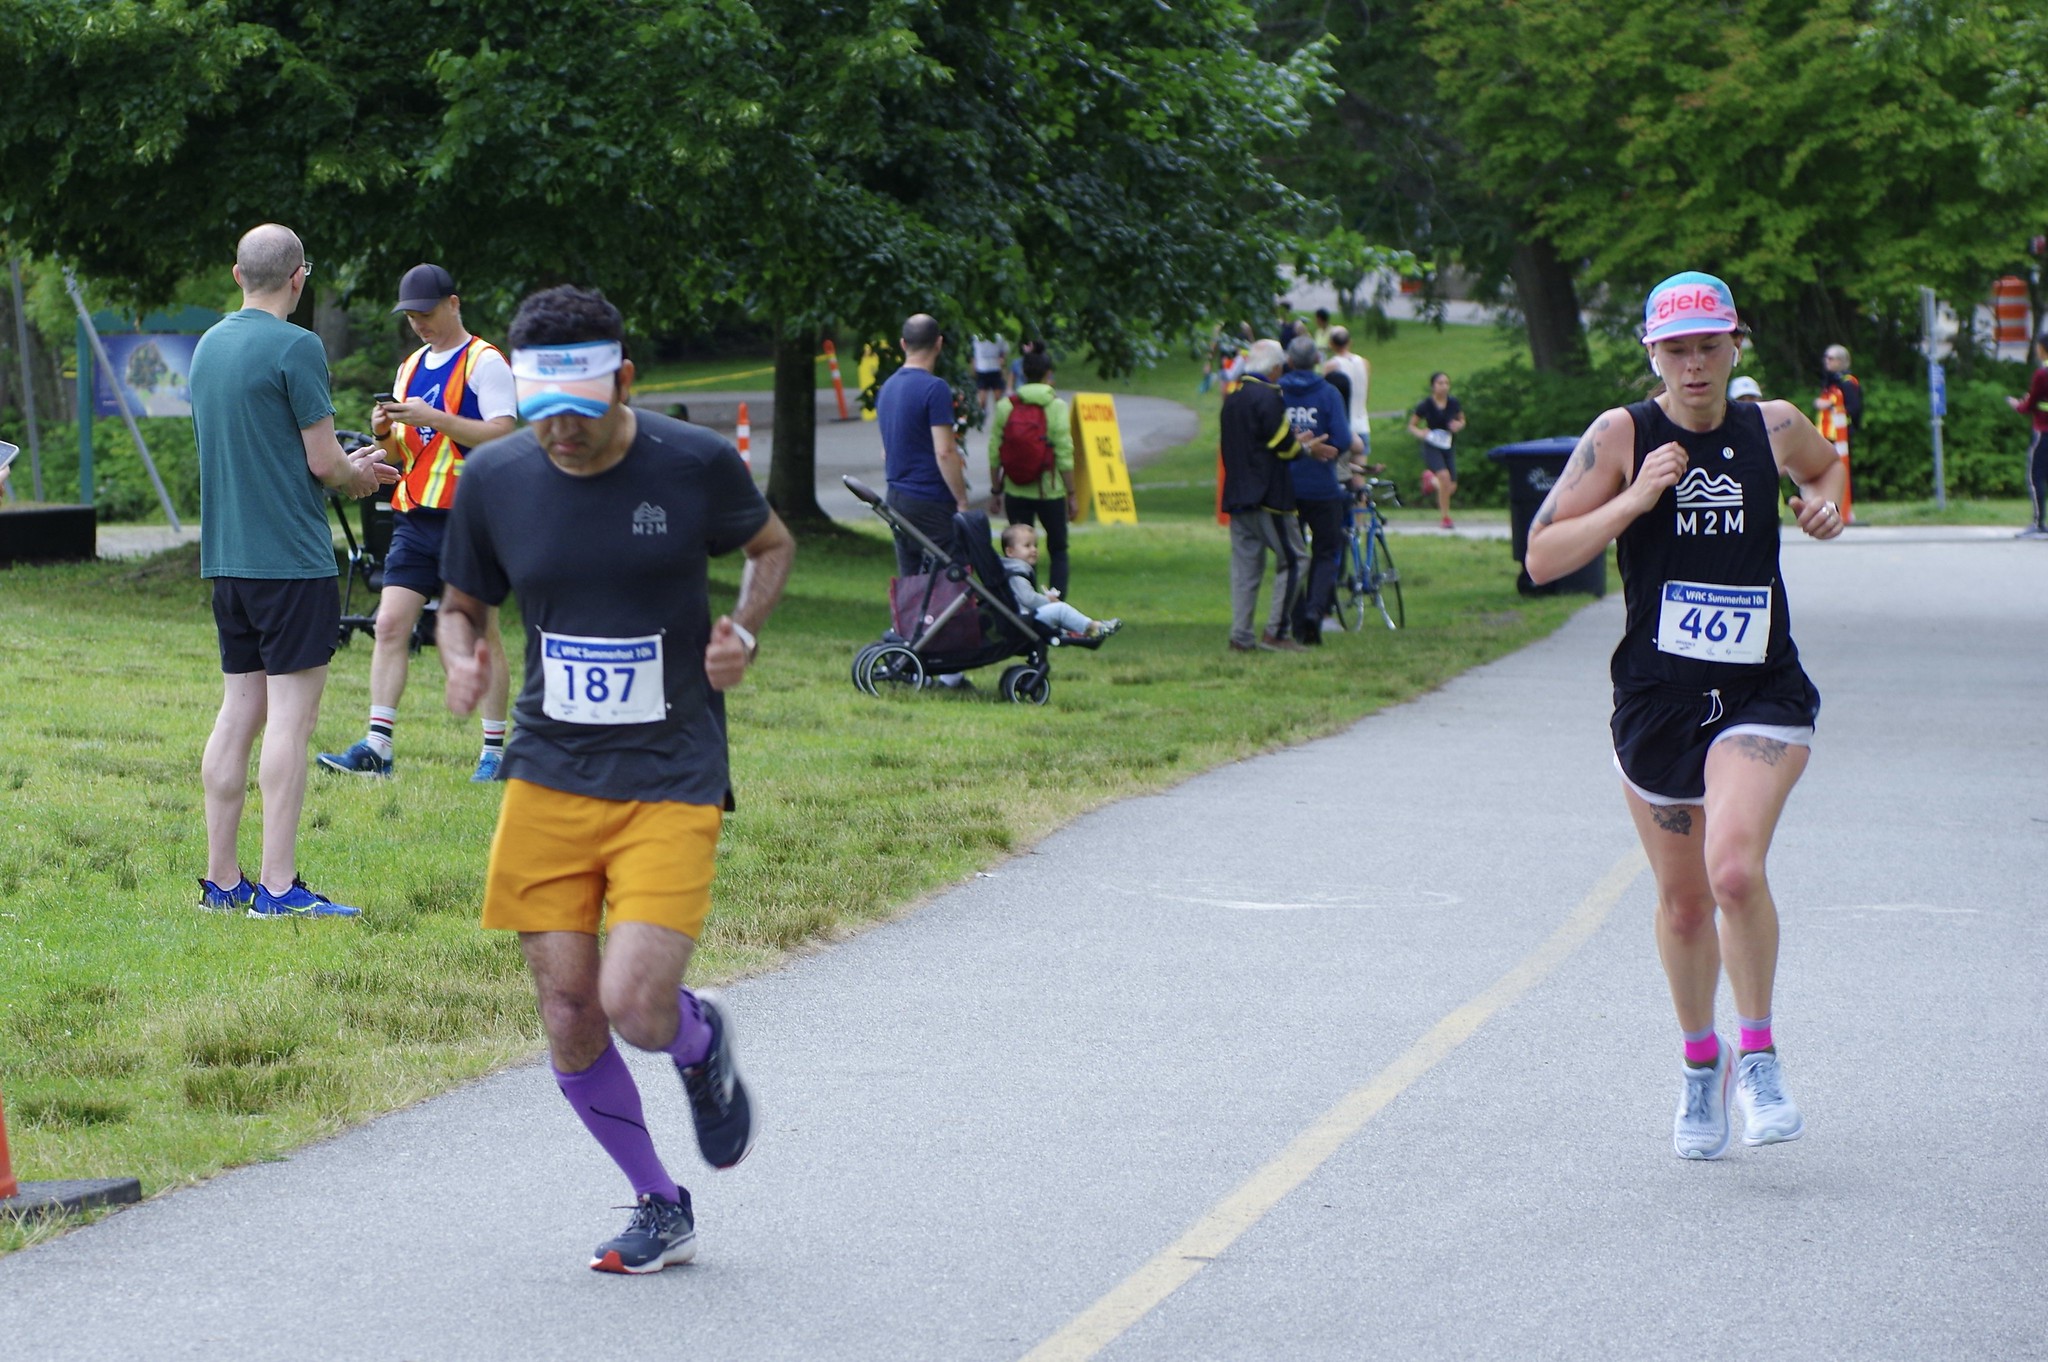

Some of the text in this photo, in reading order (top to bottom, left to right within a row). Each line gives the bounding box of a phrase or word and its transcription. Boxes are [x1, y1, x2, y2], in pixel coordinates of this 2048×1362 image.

[1658, 290, 1716, 319] ciele
[1679, 607, 1752, 644] 467
[563, 665, 635, 702] 187
